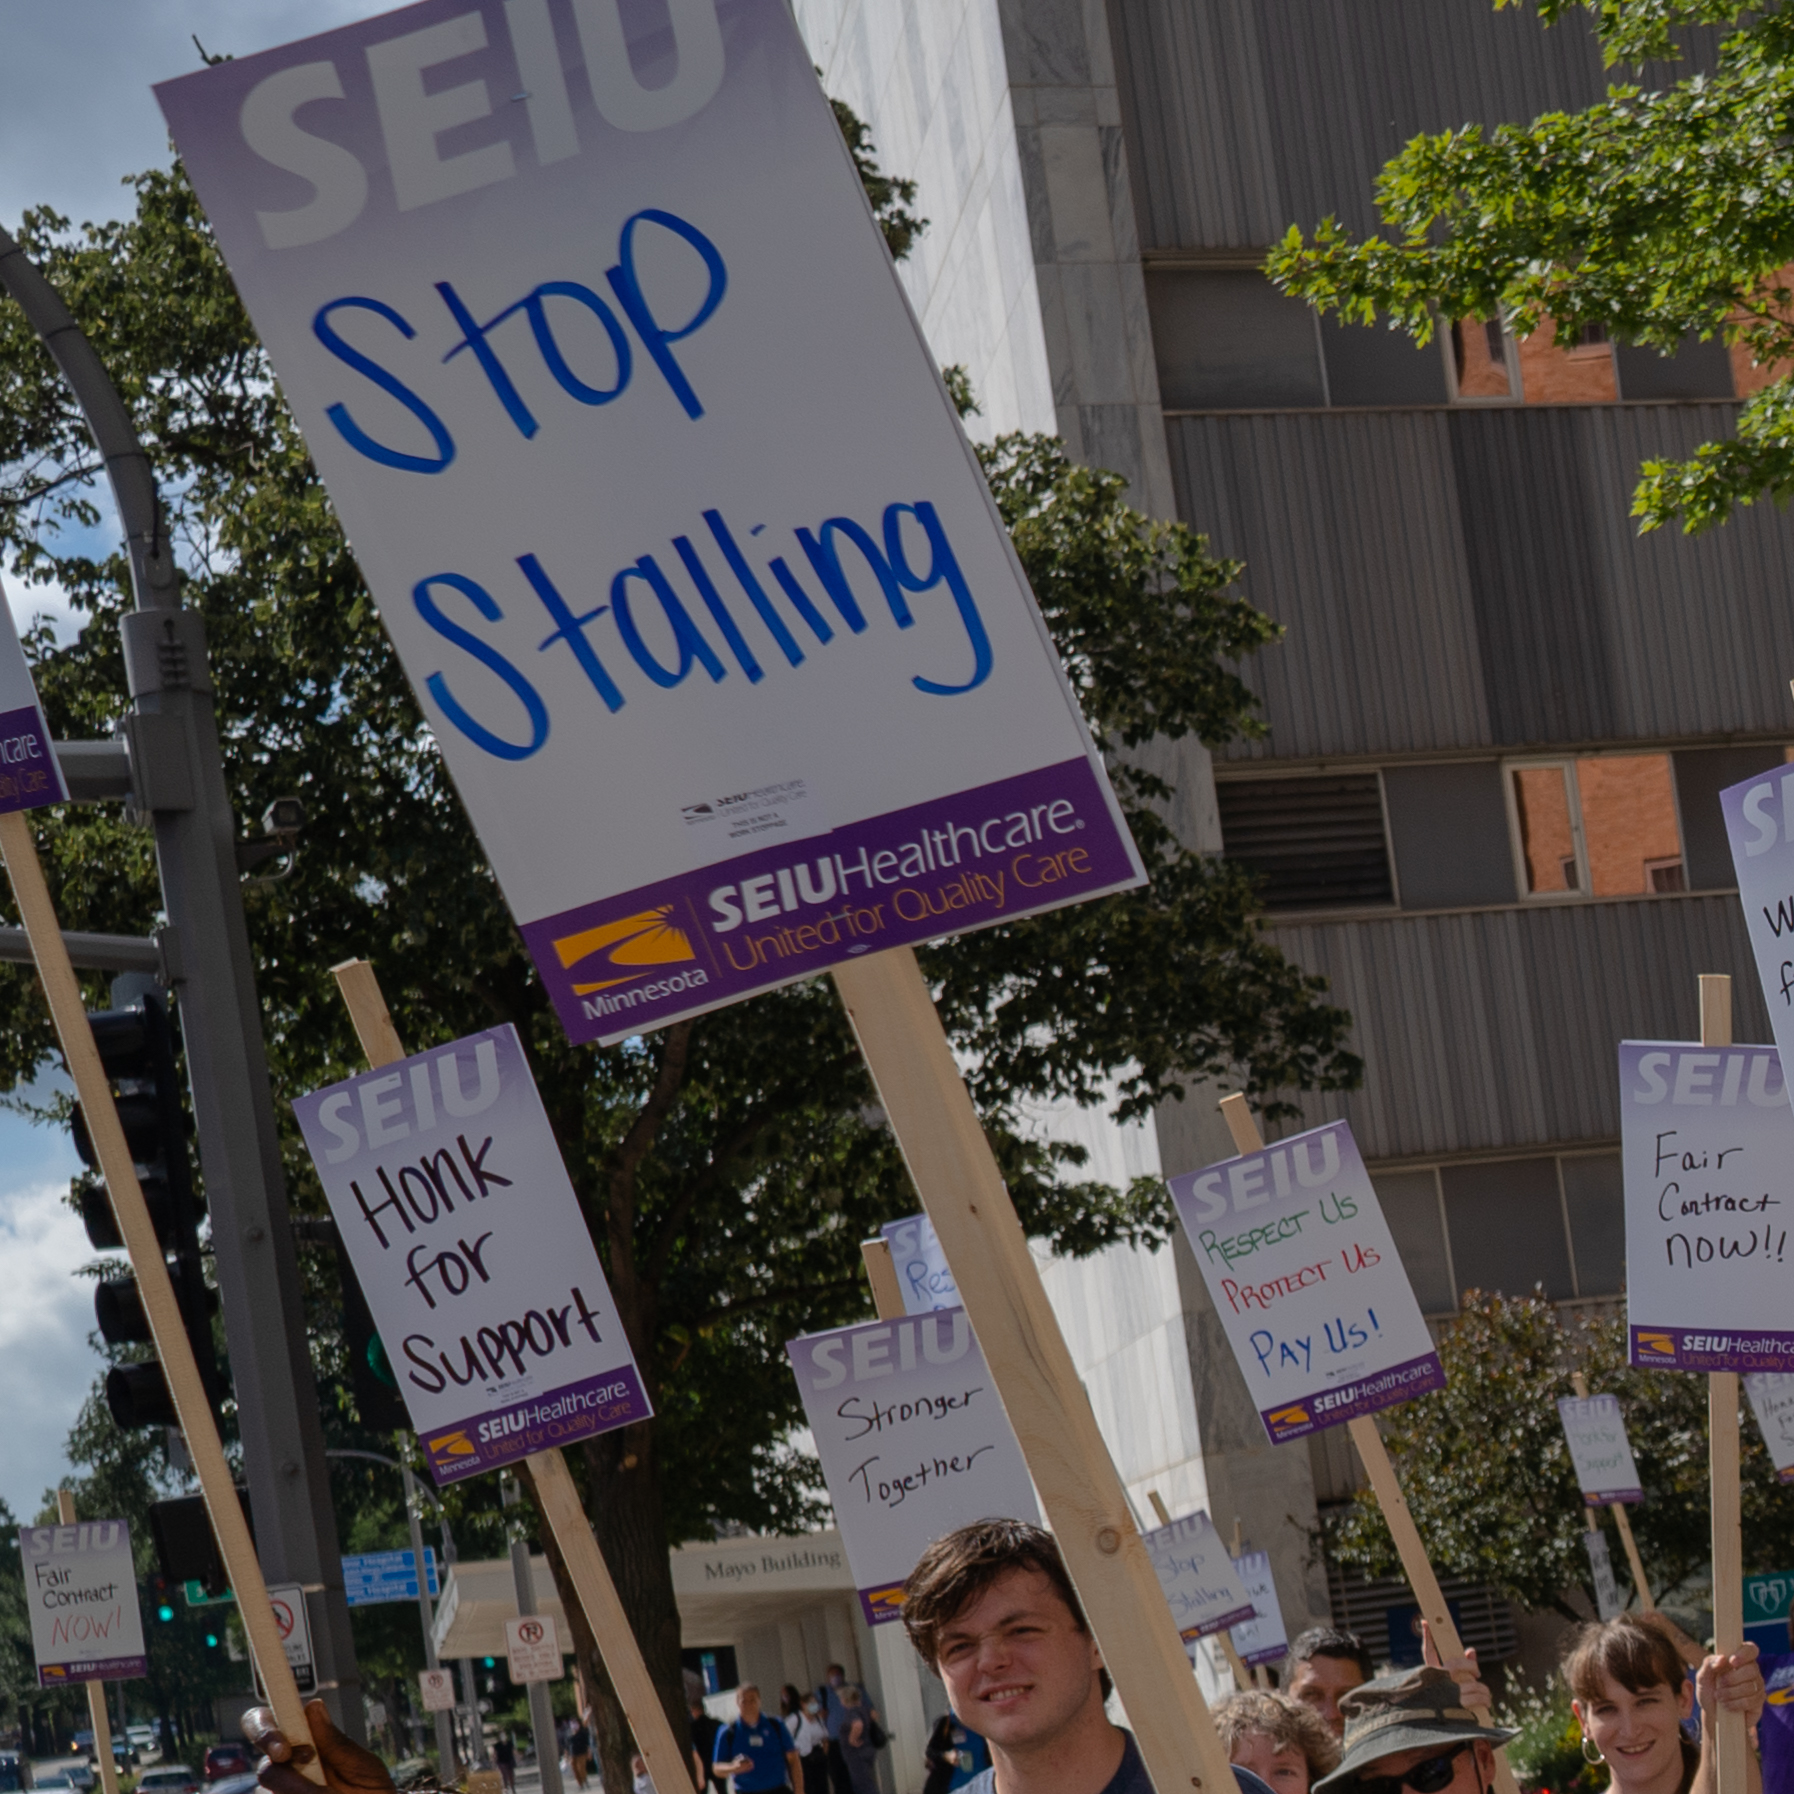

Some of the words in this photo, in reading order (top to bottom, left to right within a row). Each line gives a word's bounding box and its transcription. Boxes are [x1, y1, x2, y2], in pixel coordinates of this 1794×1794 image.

[237, 0, 727, 251] SEIU
[312, 208, 728, 474] Stop
[412, 499, 994, 761] Stalling
[707, 799, 1076, 932] SEIUHealthcare
[721, 910, 841, 973] United
[841, 900, 886, 939] for
[892, 868, 1005, 924] Quality
[1011, 844, 1093, 895] Care
[582, 967, 709, 1020] Minnesota
[318, 1039, 500, 1164] SEIU
[1633, 1053, 1790, 1107] SEIU
[1192, 1131, 1340, 1225] SEIU
[1655, 1131, 1743, 1178] Fair
[350, 1135, 513, 1249] Honk
[1658, 1183, 1780, 1221] Contract
[404, 1231, 493, 1309] for
[402, 1287, 602, 1394] Support
[811, 1309, 971, 1392] SEIU
[478, 1381, 627, 1443] SEIUHealthcare
[837, 1387, 984, 1440] Stronger
[439, 1455, 481, 1476] Minnesota
[849, 1446, 995, 1507] Together
[30, 1522, 119, 1557] SEIU
[705, 1561, 756, 1581] Mayo
[762, 1550, 841, 1573] Building
[35, 1562, 71, 1588] Fair
[43, 1583, 118, 1609] Contract
[52, 1605, 121, 1646] NOW!
